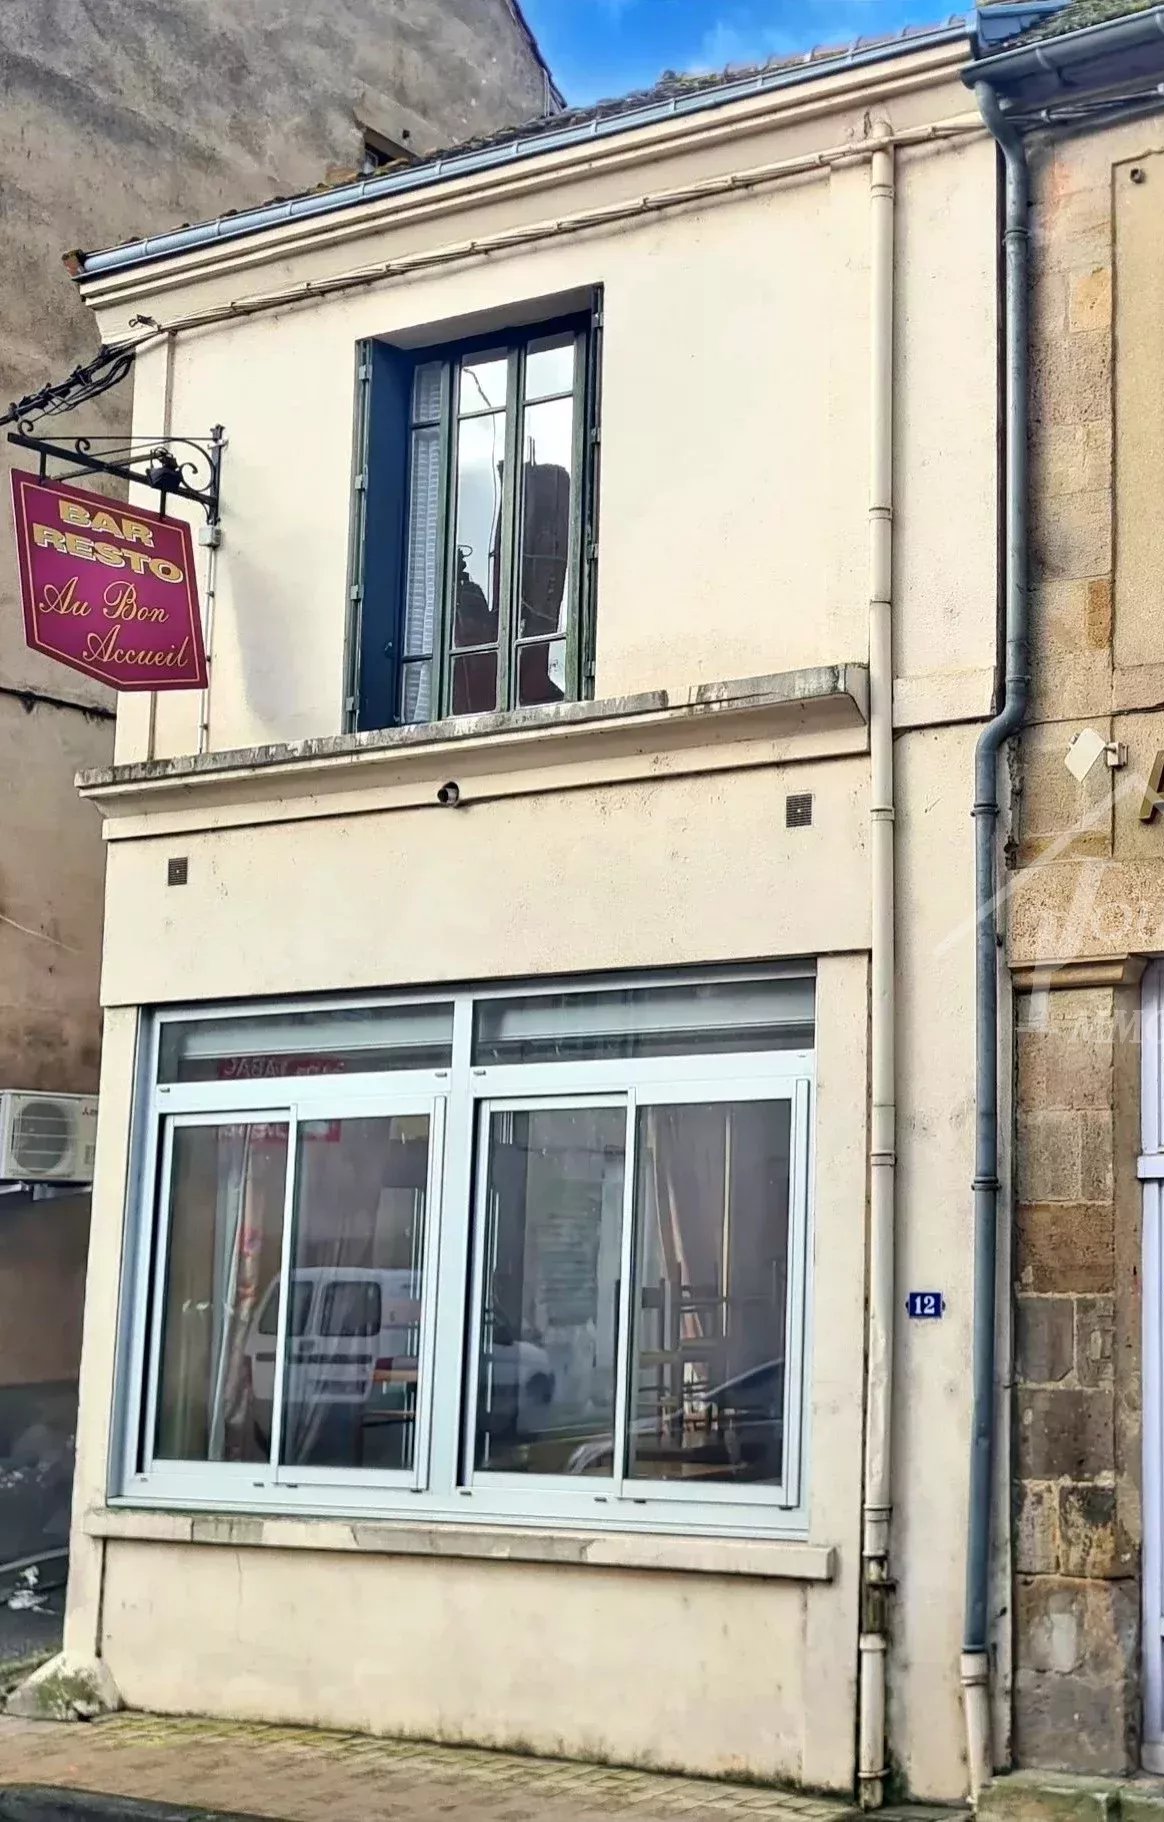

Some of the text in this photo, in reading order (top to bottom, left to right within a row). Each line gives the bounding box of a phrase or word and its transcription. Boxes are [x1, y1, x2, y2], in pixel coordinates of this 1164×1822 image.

[59, 500, 154, 547] BAR
[33, 523, 184, 584] RESTO
[40, 577, 170, 623] Au Bon
[82, 624, 189, 668] Accueil
[915, 1295, 935, 1314] 12
